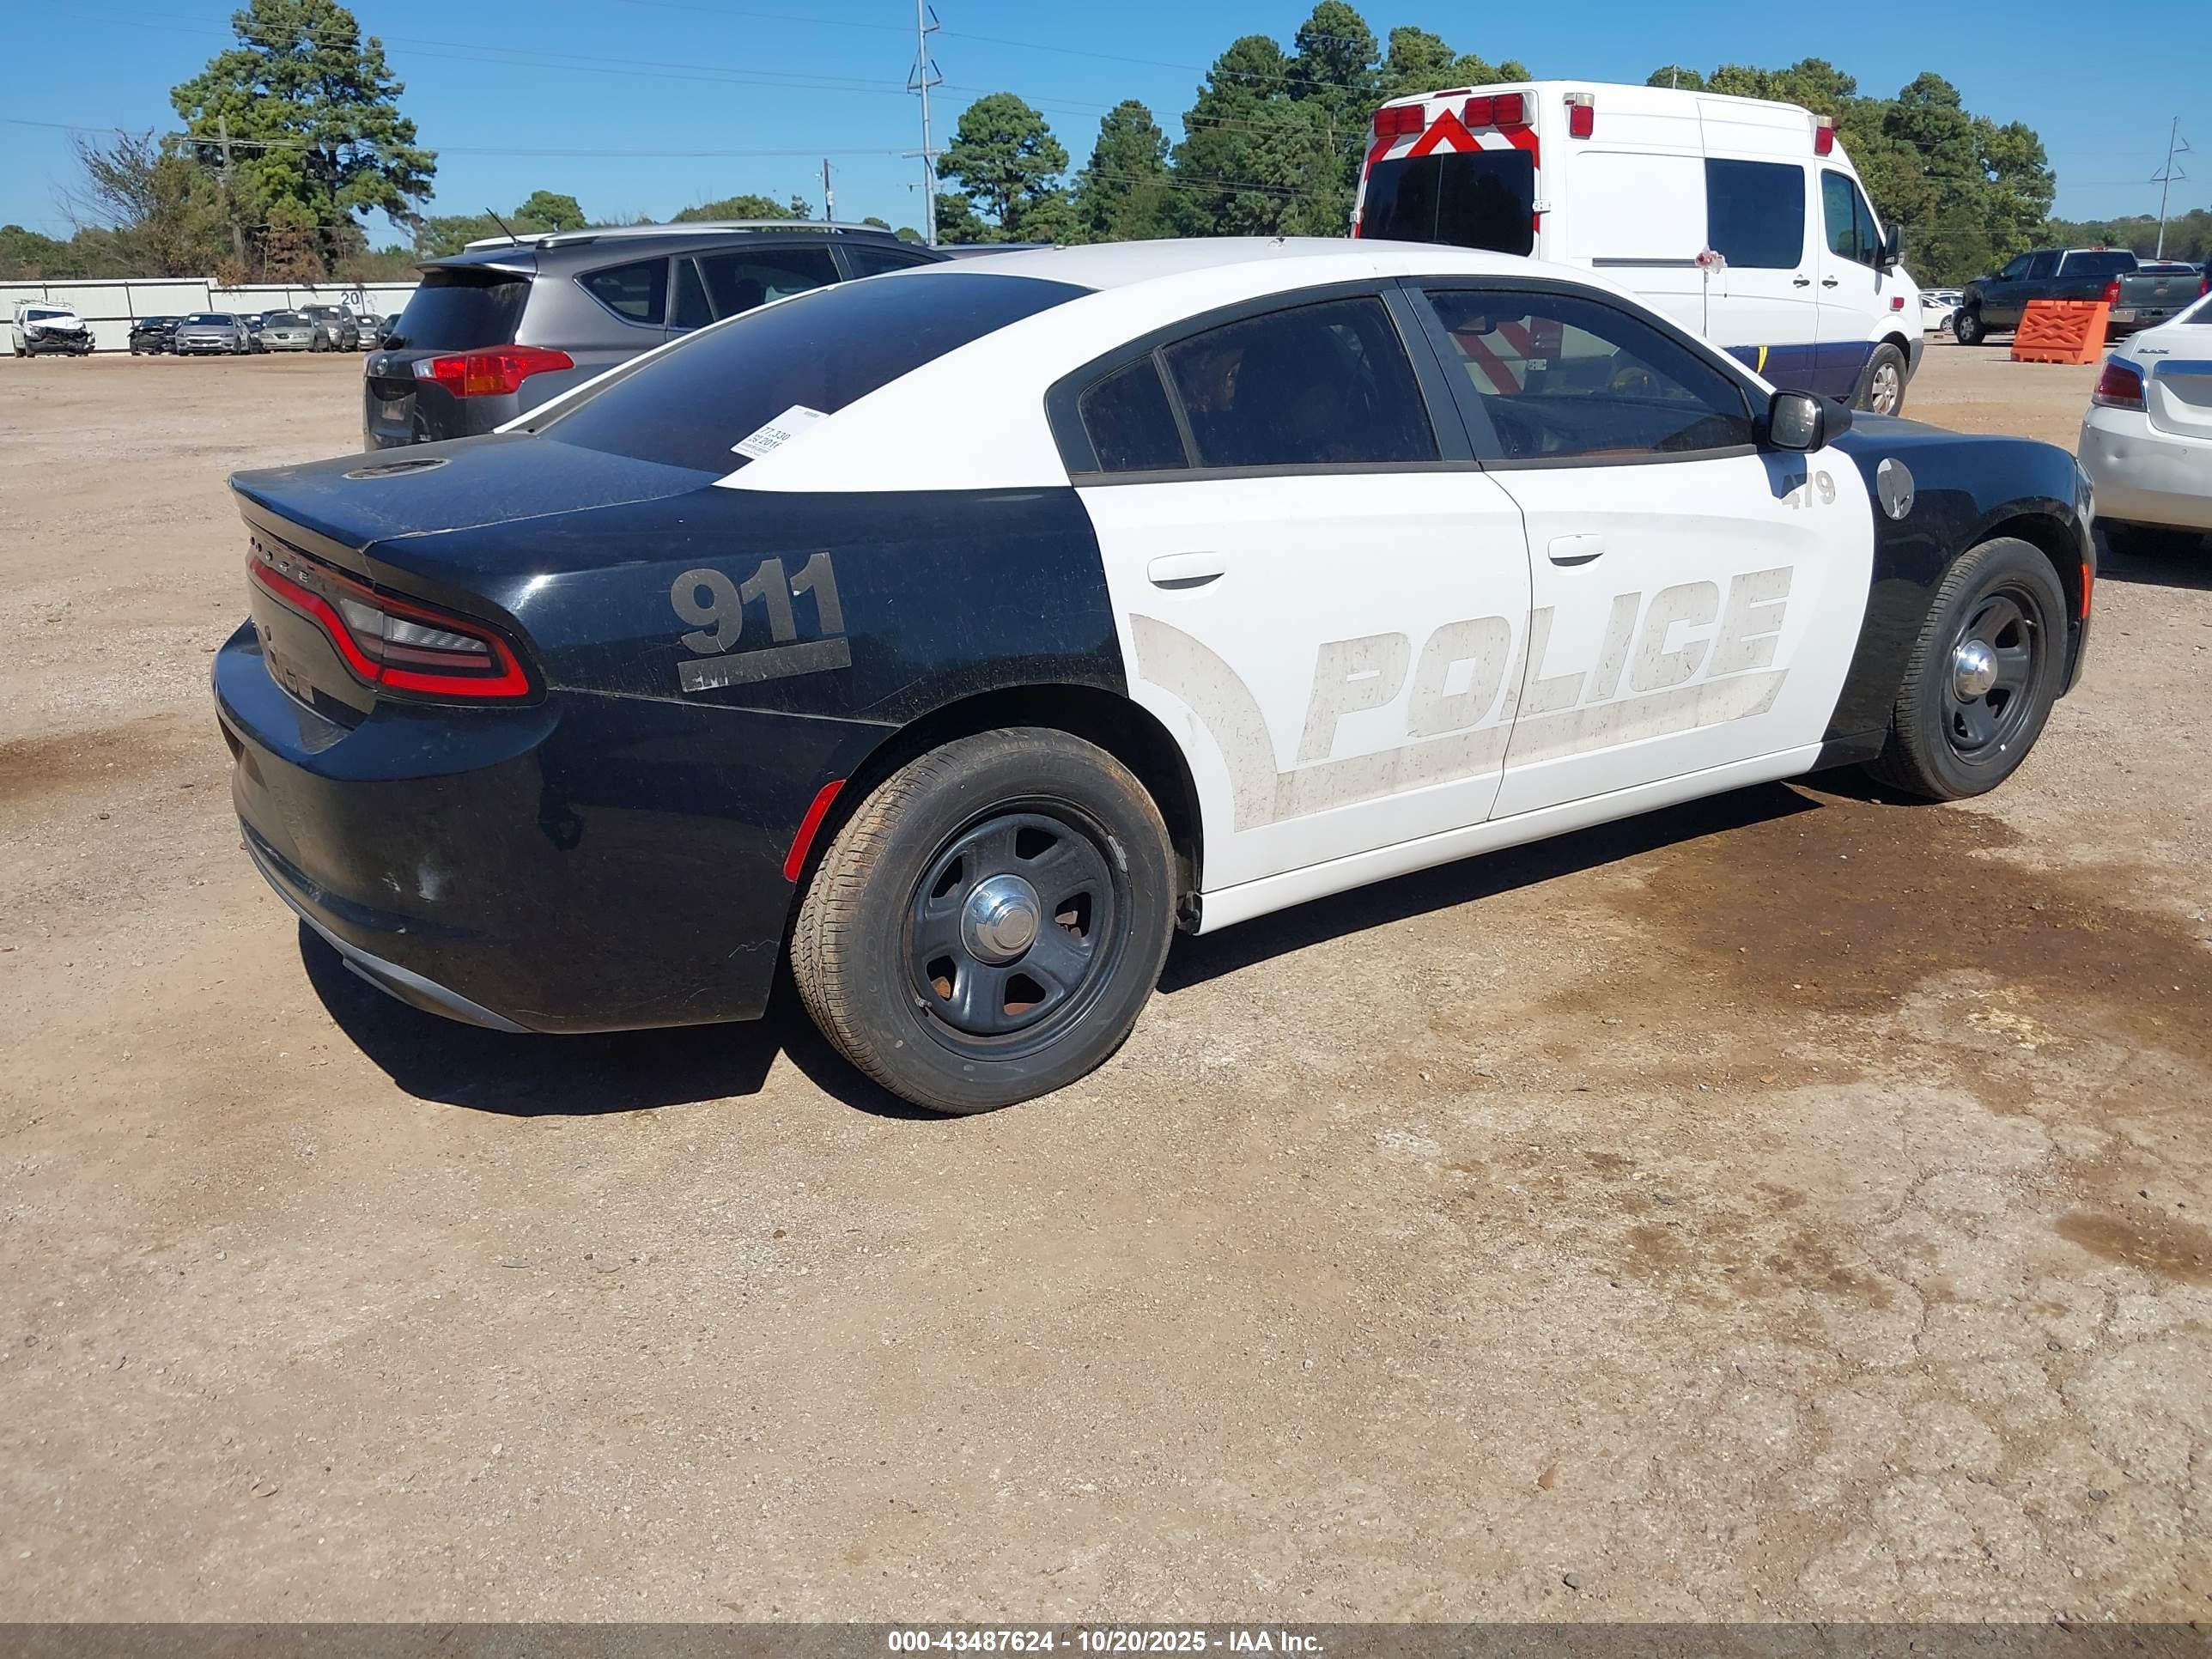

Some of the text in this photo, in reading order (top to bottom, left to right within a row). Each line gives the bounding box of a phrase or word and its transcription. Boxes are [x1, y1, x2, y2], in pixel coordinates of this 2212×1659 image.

[341, 292, 359, 305] 20
[671, 551, 845, 654] 911
[1296, 566, 1794, 763] POLICE
